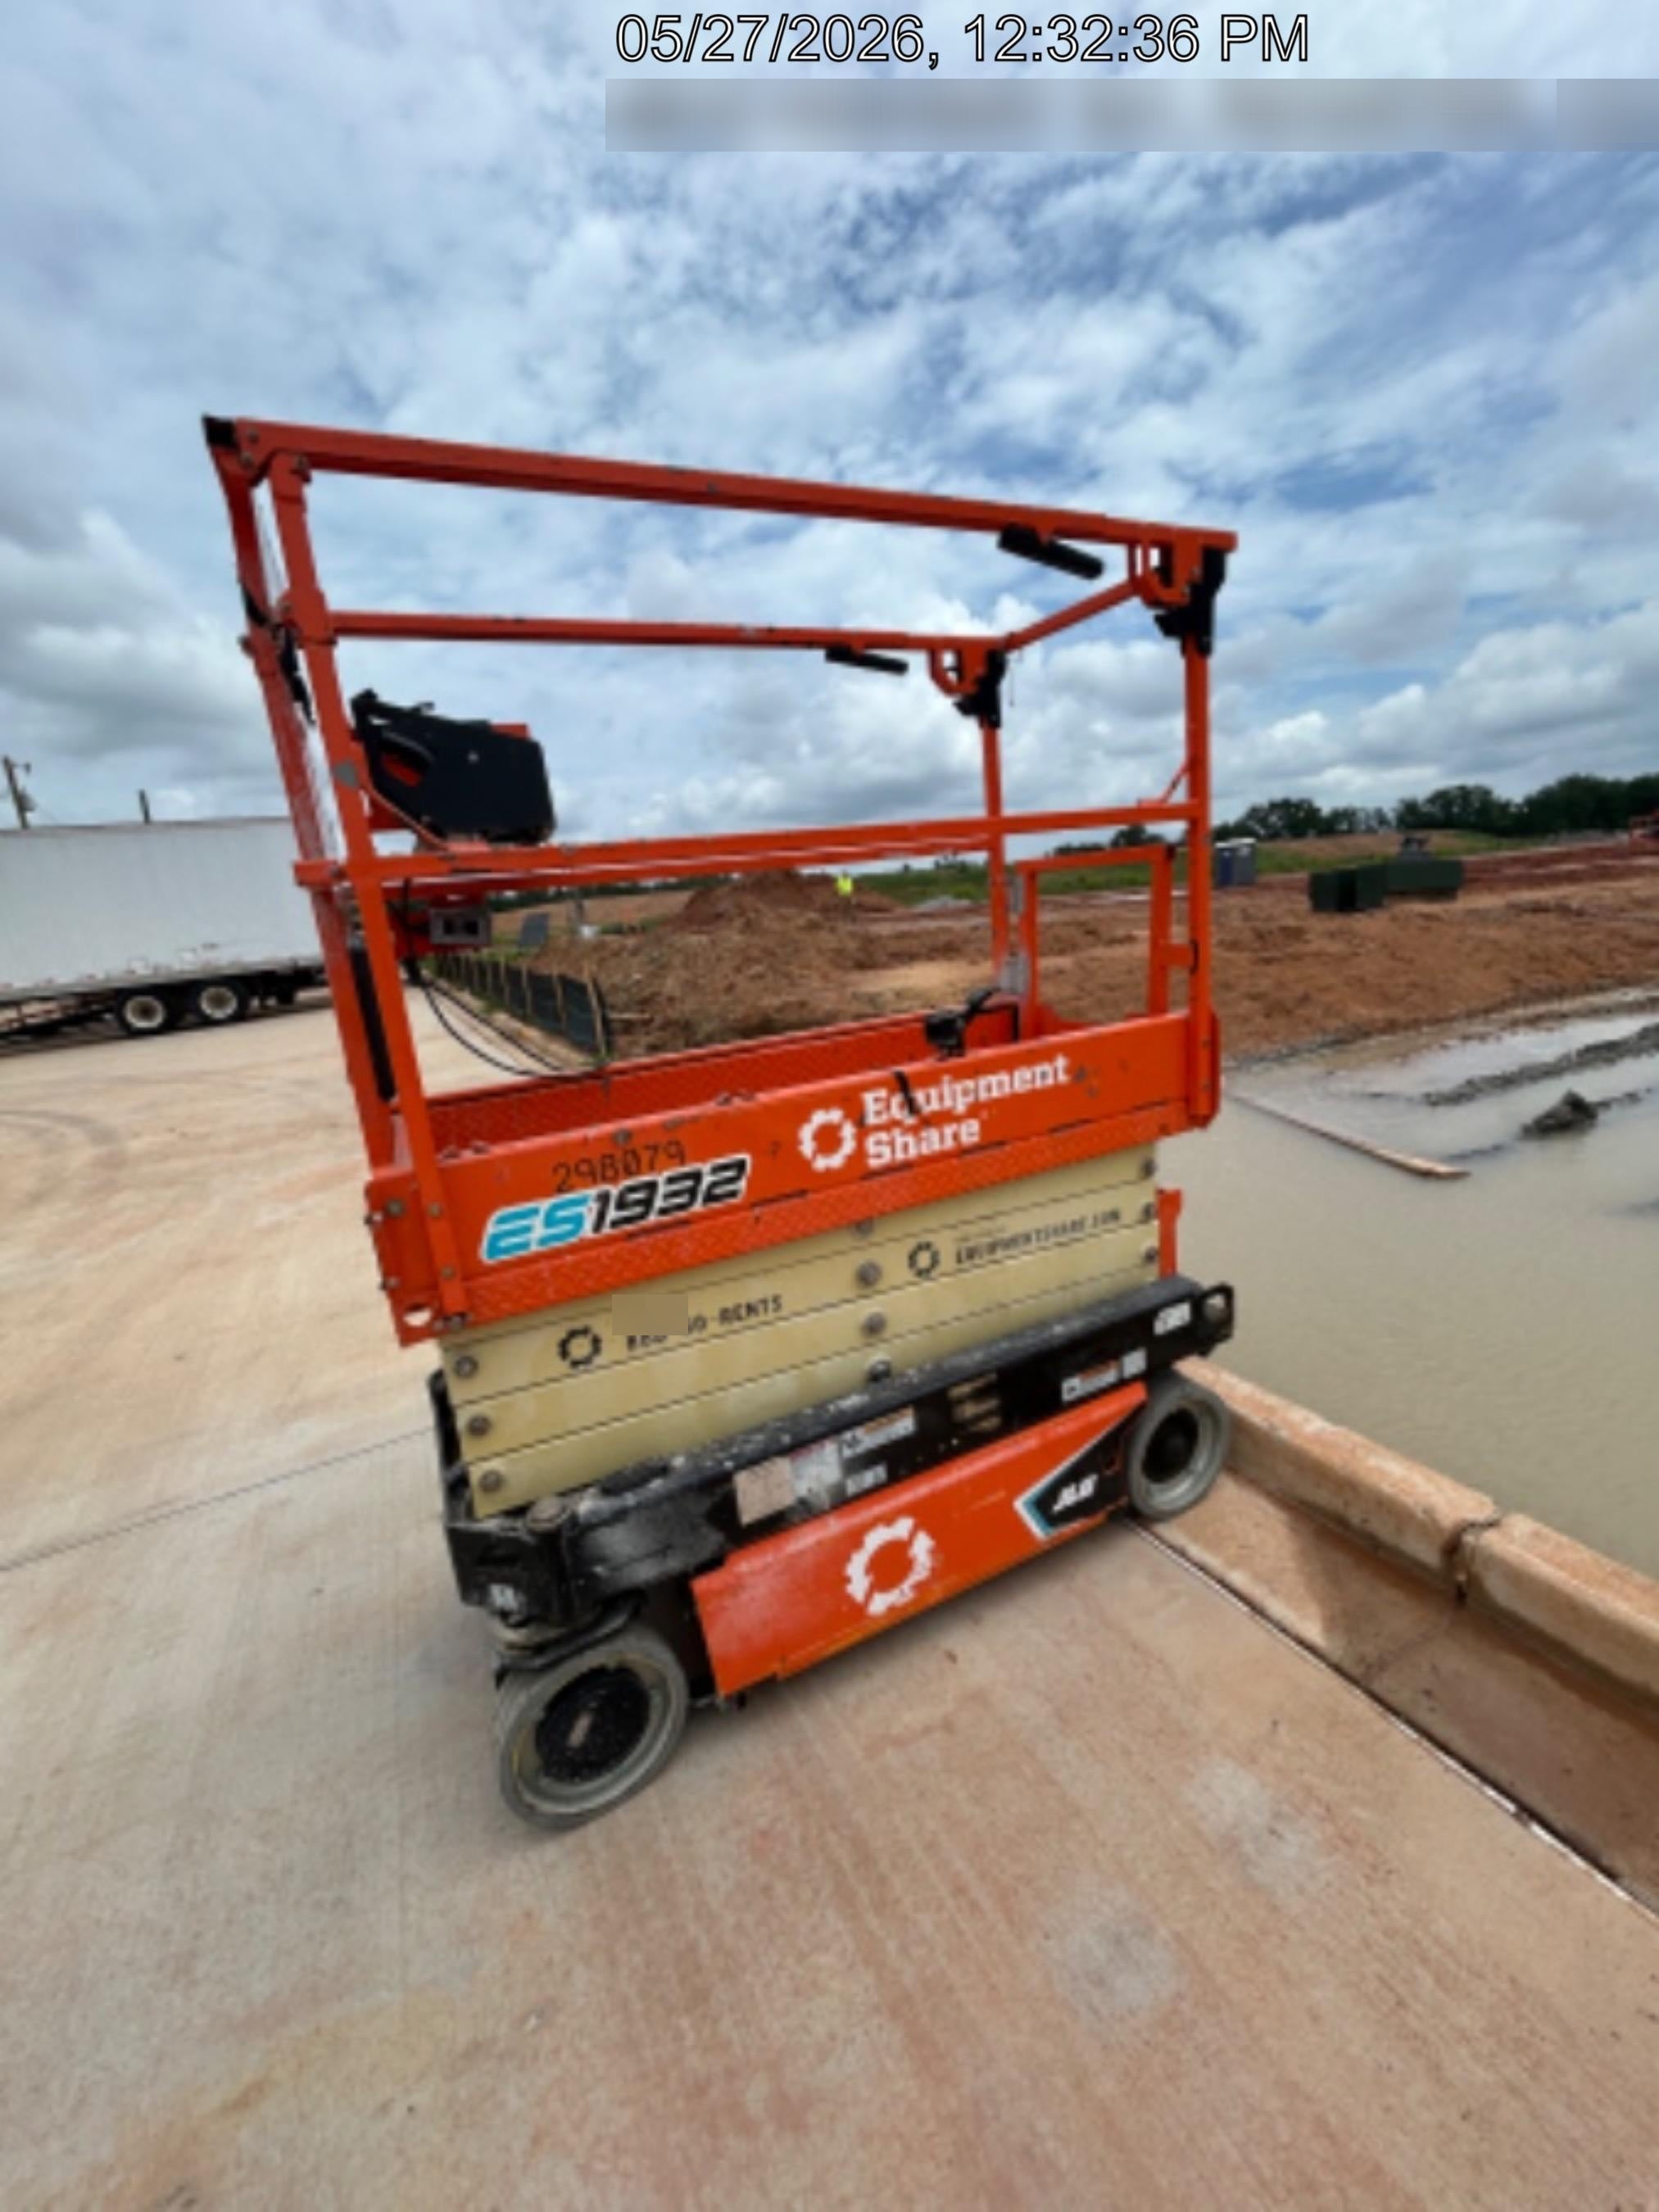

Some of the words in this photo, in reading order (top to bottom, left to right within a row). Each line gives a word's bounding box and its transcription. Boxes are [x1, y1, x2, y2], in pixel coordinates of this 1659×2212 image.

[863, 1054, 1070, 1125] Equipment
[865, 1117, 981, 1168] Share
[479, 1153, 751, 1263] ES1932
